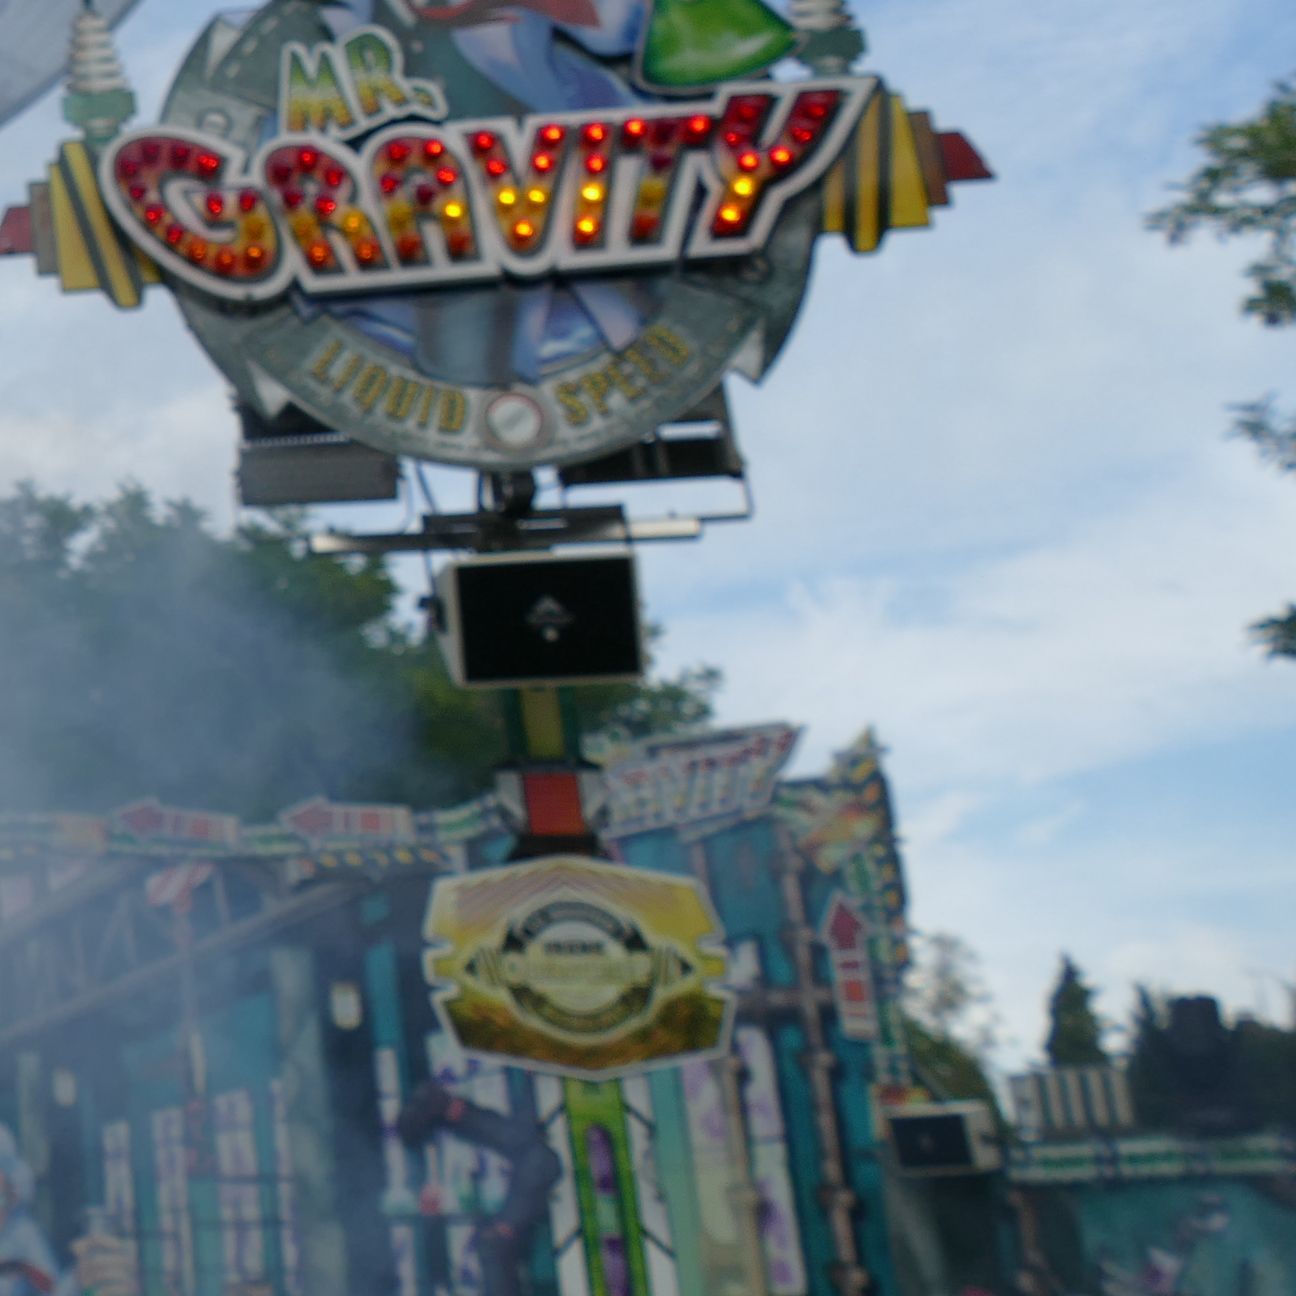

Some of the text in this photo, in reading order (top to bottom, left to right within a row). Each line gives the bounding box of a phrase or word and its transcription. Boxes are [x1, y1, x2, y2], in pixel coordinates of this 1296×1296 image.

[282, 27, 444, 136] MR.
[102, 78, 870, 298] GRAVITY
[311, 323, 690, 433] LIQUID SPEED
